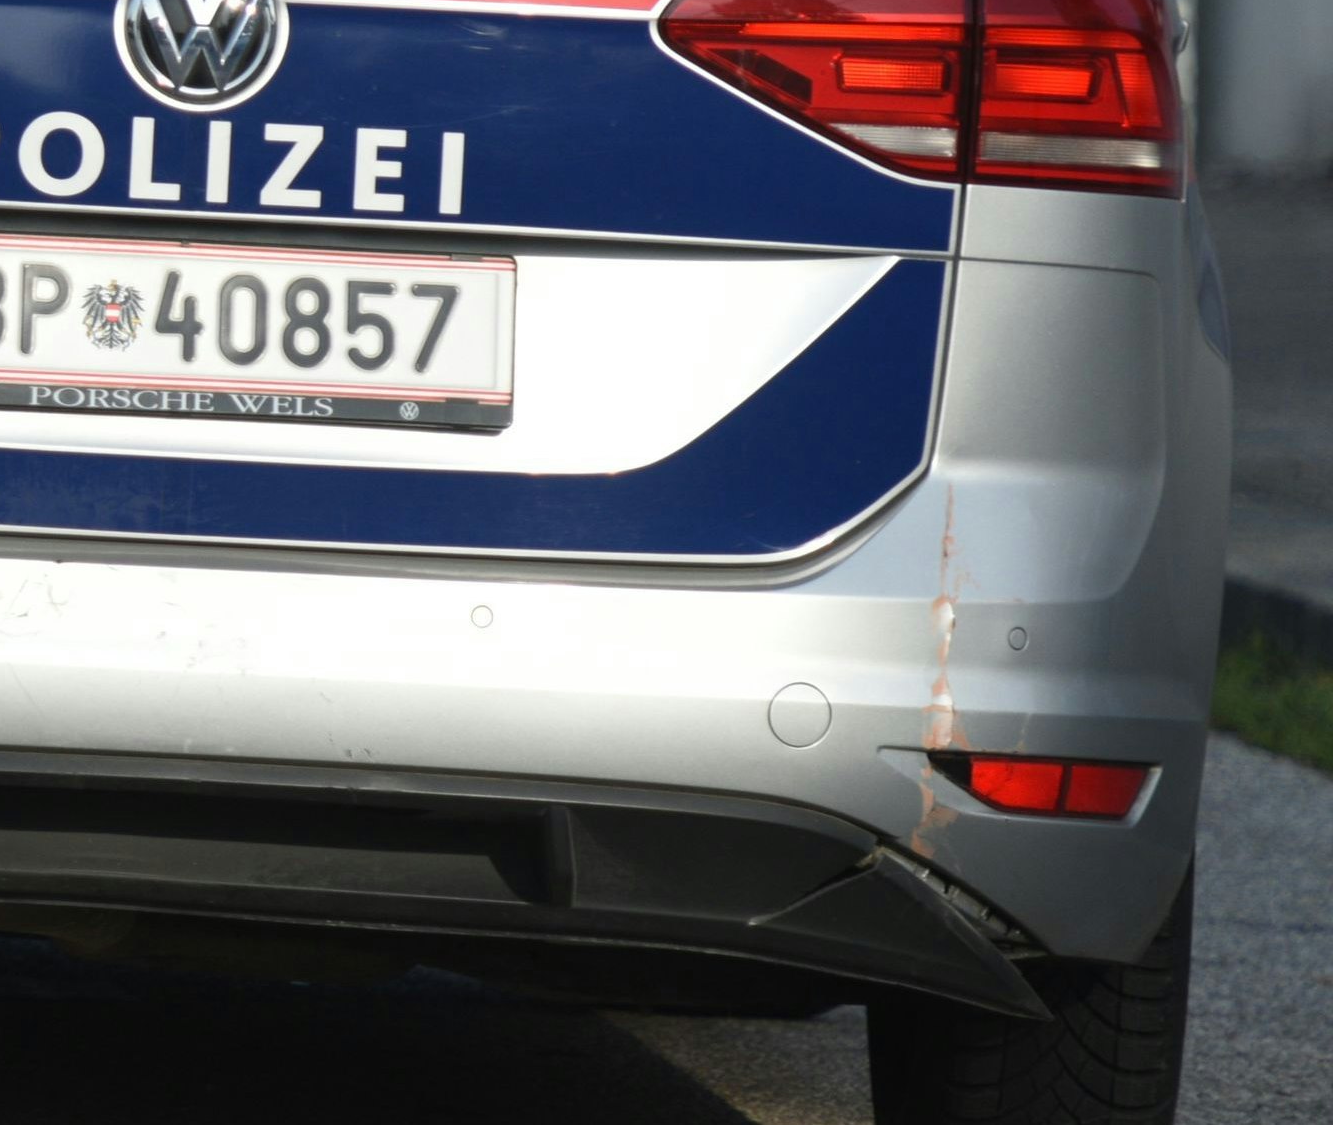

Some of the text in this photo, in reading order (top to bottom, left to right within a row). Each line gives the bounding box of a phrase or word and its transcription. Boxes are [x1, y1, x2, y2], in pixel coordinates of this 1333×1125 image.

[154, 269, 461, 374] 40857
[28, 385, 334, 418] PORSCHE WELS
